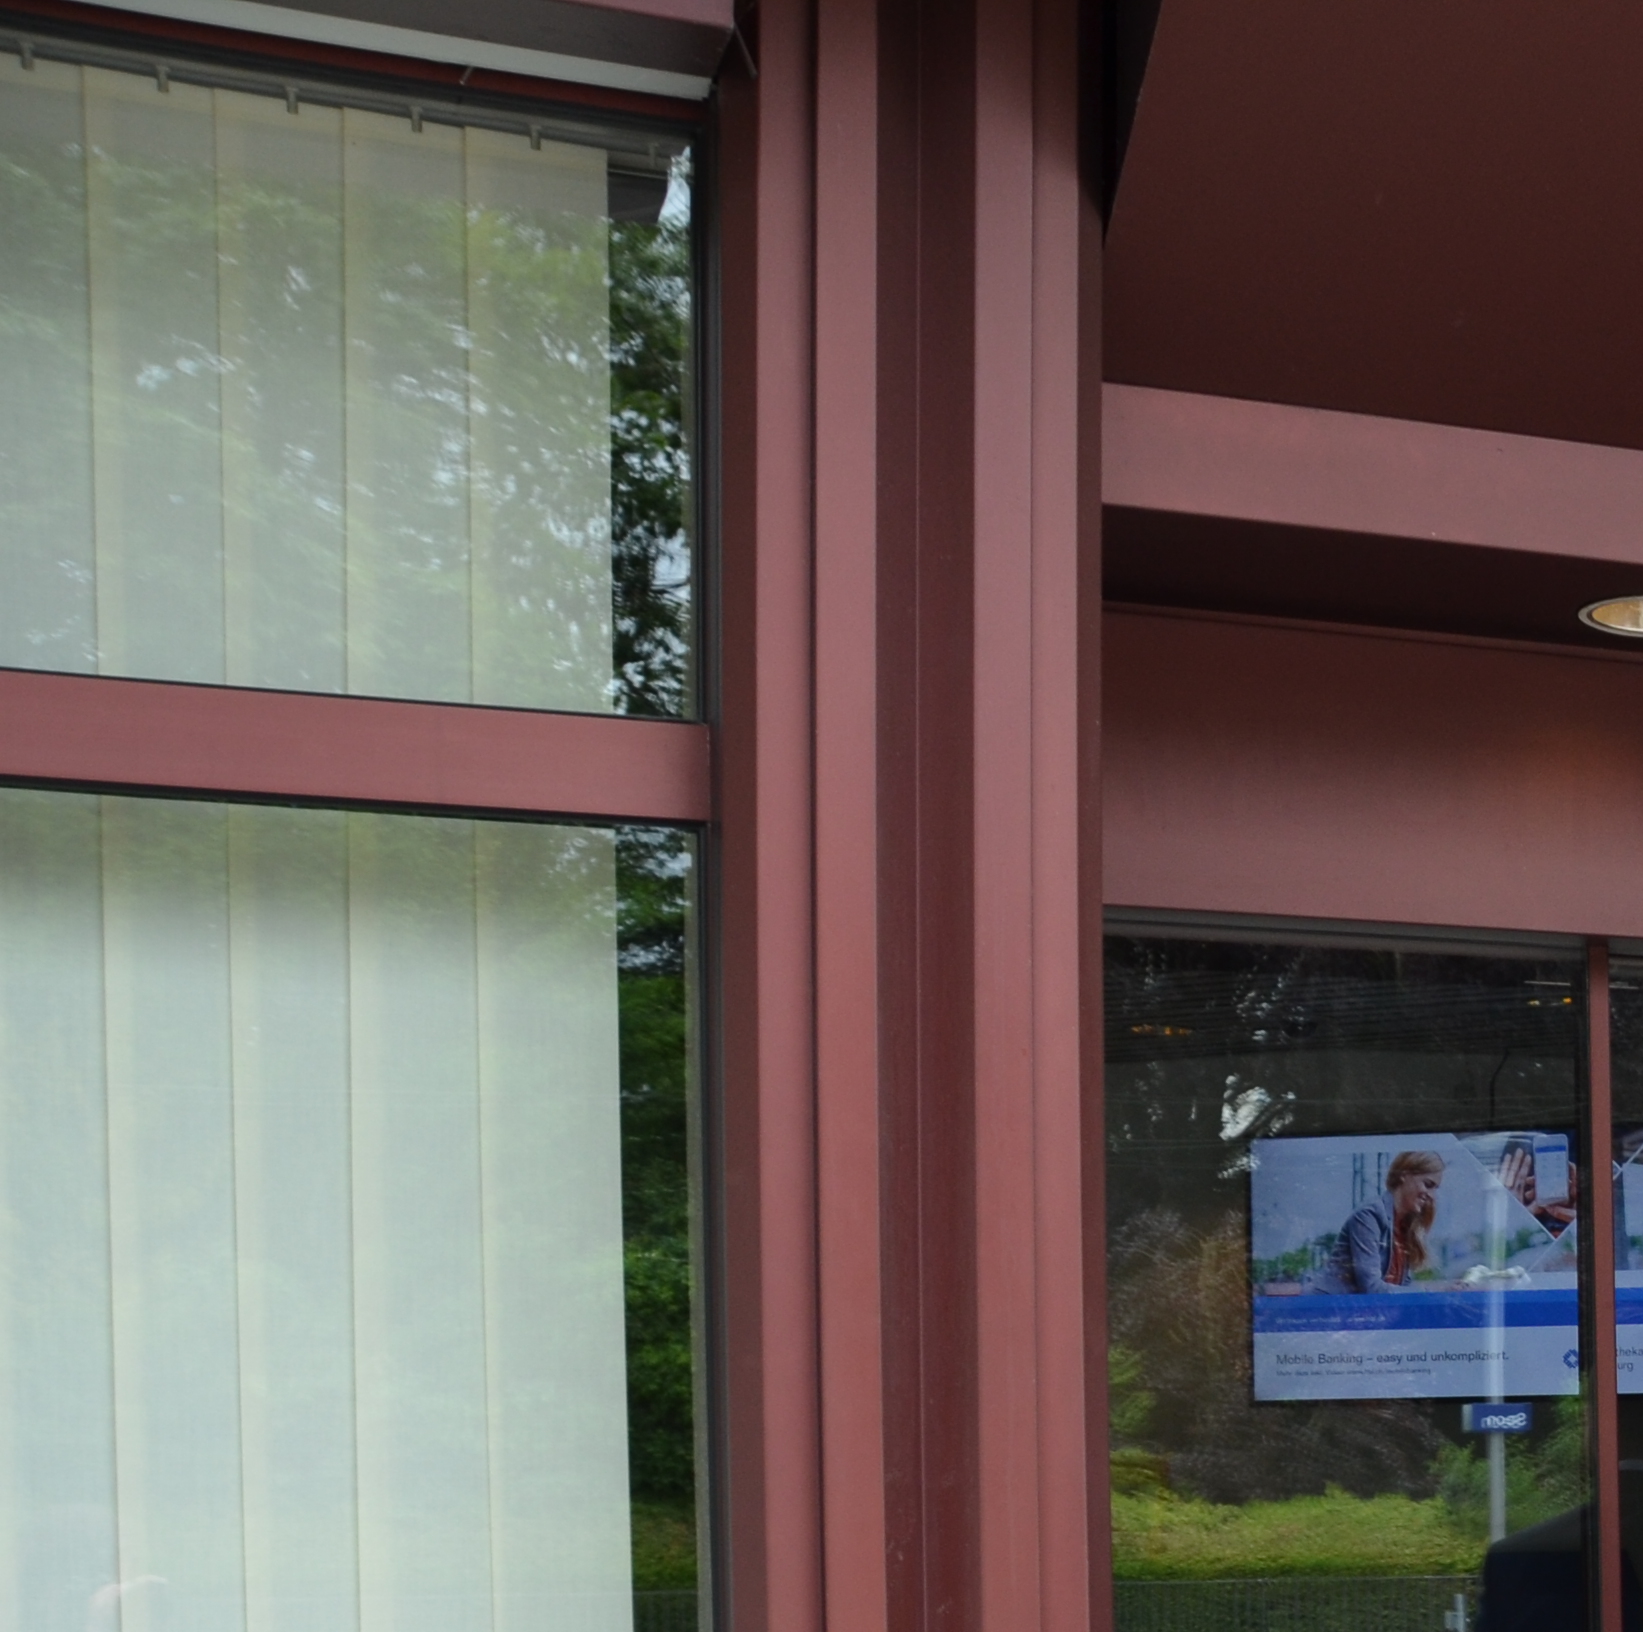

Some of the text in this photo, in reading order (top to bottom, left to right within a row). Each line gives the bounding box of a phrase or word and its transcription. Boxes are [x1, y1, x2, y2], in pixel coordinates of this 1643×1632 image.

[1276, 1353, 1314, 1365] Mobile
[1317, 1352, 1363, 1368] Banking
[1376, 1354, 1403, 1366] easy
[1406, 1351, 1427, 1363] und
[1430, 1349, 1510, 1365] unkompliziert.
